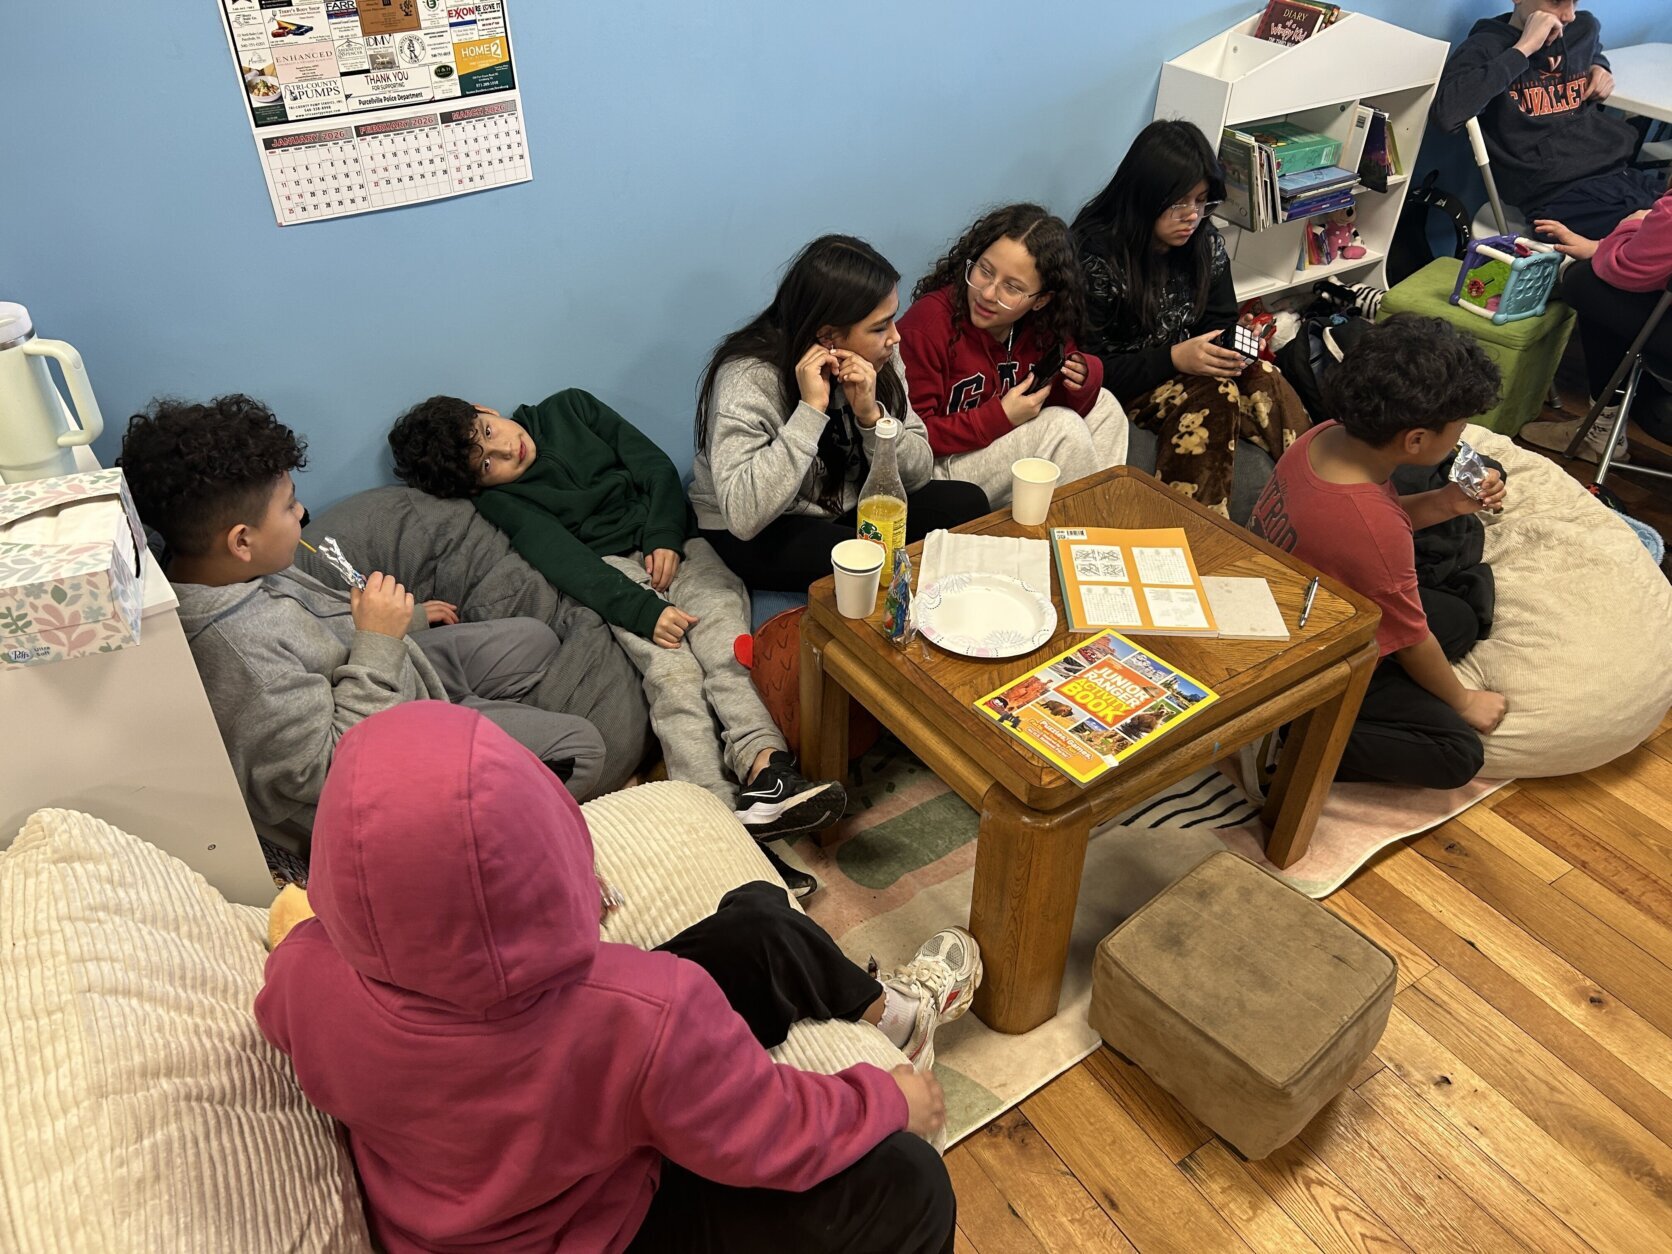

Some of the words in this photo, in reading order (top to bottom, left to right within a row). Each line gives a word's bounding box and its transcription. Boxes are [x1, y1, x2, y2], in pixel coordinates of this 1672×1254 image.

[326, 1, 354, 10] FARR
[448, 7, 475, 19] EXXON
[1283, 9, 1308, 21] DIARY
[276, 51, 333, 63] ENHANCED
[365, 72, 392, 85] THANK
[392, 71, 409, 81] YOU
[291, 80, 337, 90] TRI-COUNTY
[380, 82, 405, 90] SUPPORTING
[298, 86, 340, 100] PUMPS
[397, 92, 423, 102] Department
[412, 117, 433, 126] 2026
[322, 131, 345, 139] 2026
[947, 362, 1035, 415] GA
[12, 650, 29, 660] Puffs
[1084, 671, 1140, 708] RANGER
[1094, 667, 1150, 701] JUNIOR
[1075, 677, 1132, 711] ACTIVITY
[1061, 682, 1126, 723] BOOK
